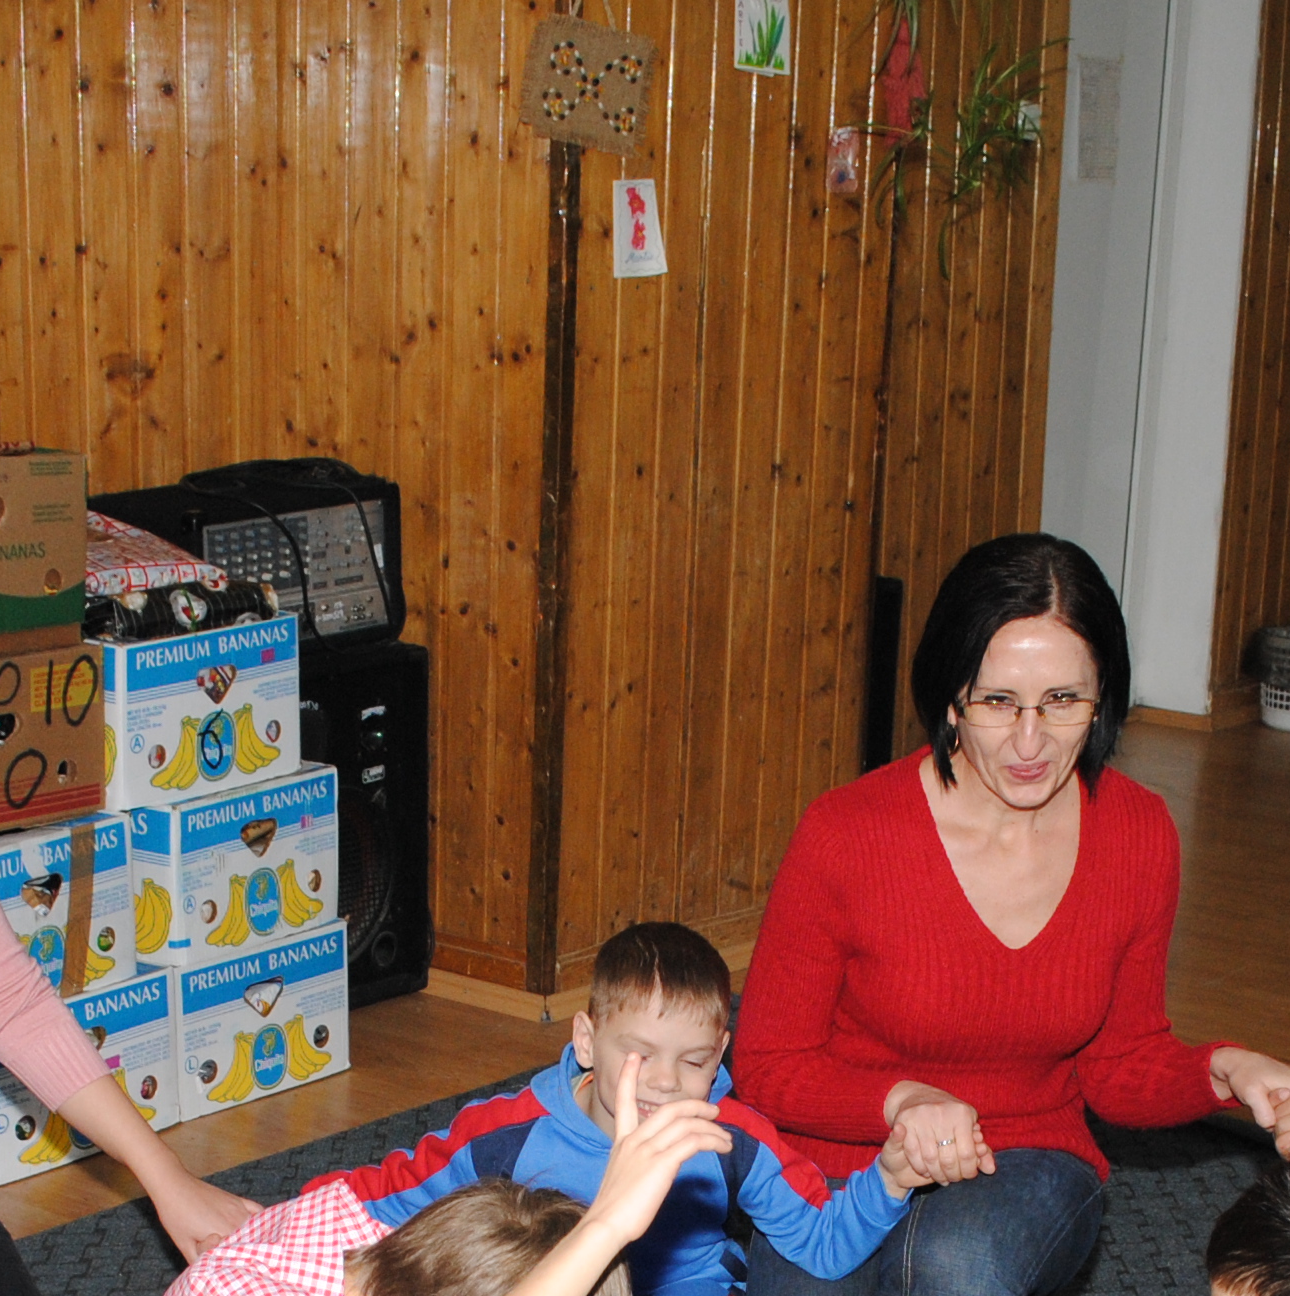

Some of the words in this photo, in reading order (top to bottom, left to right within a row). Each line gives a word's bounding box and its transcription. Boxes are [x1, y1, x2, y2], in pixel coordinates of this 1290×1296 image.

[136, 639, 210, 671] PREMIUM
[218, 623, 289, 655] BANANAS
[45, 654, 98, 727] 10
[196, 708, 224, 770] 6
[187, 799, 256, 833] PREMIUM
[262, 779, 328, 813] BANANAS
[189, 958, 261, 993] PREMIUM
[268, 936, 338, 970] BANANAS
[85, 982, 160, 1021] BANANAS
